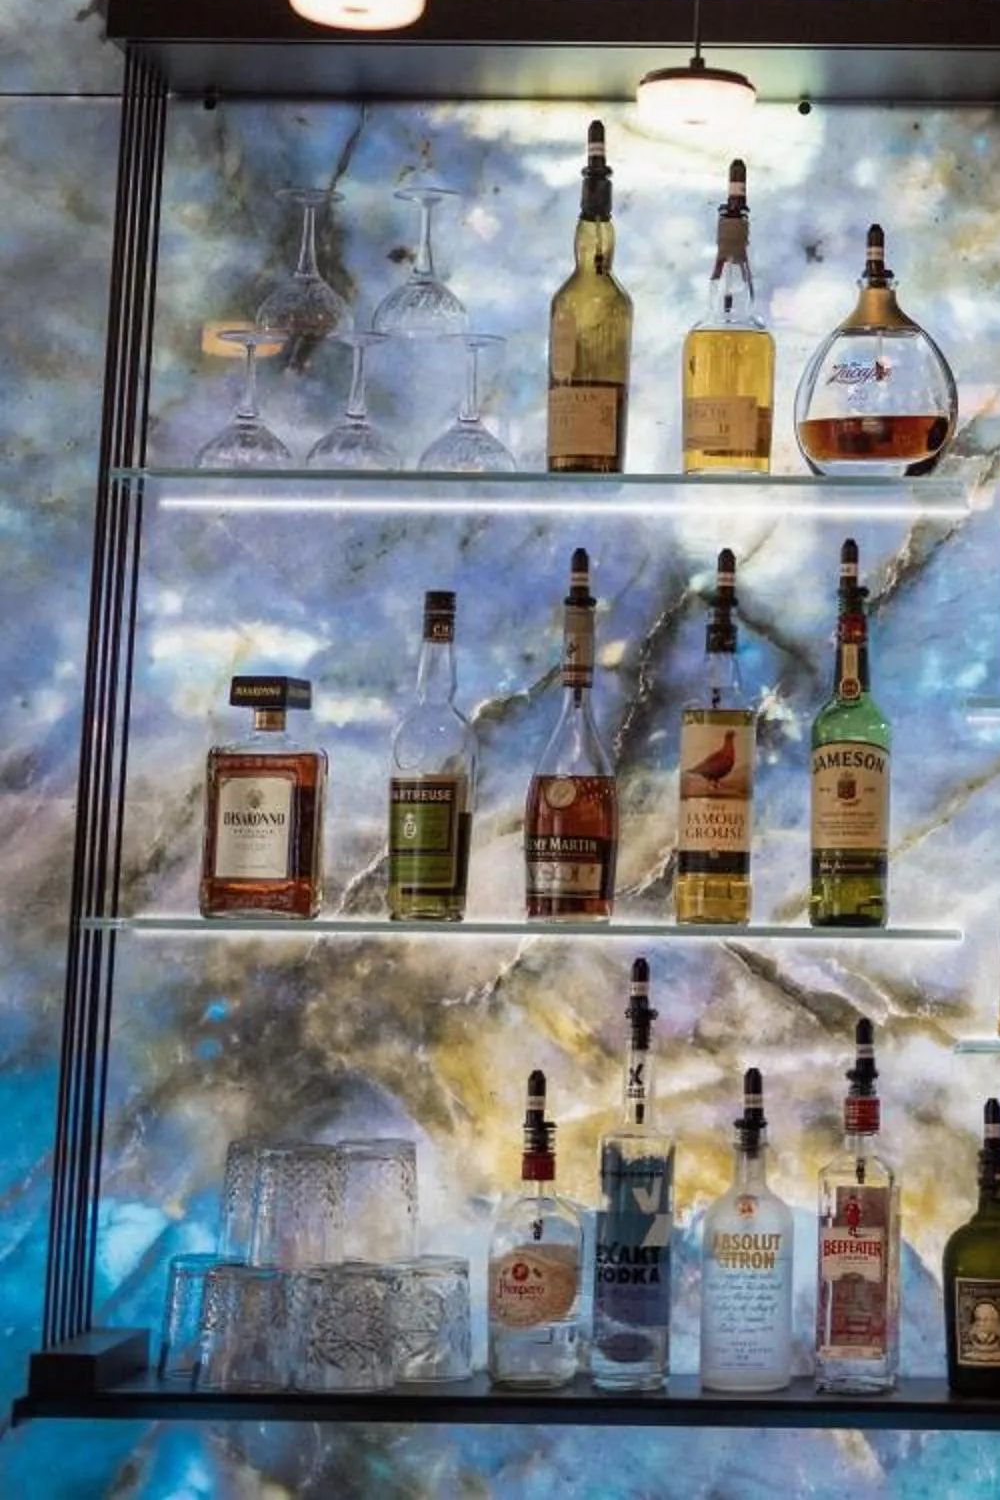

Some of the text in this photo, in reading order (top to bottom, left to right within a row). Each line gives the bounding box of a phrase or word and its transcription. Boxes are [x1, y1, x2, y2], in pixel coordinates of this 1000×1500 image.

[813, 751, 885, 775] JAMESON
[224, 811, 285, 827] DISARONNO
[687, 813, 746, 826] FAMOUS
[685, 827, 745, 839] GROUSE
[549, 837, 598, 853] MARTIN
[713, 1233, 782, 1250] ABSOLUT
[823, 1239, 882, 1257] BEEFEATER
[715, 1251, 775, 1269] CITRON
